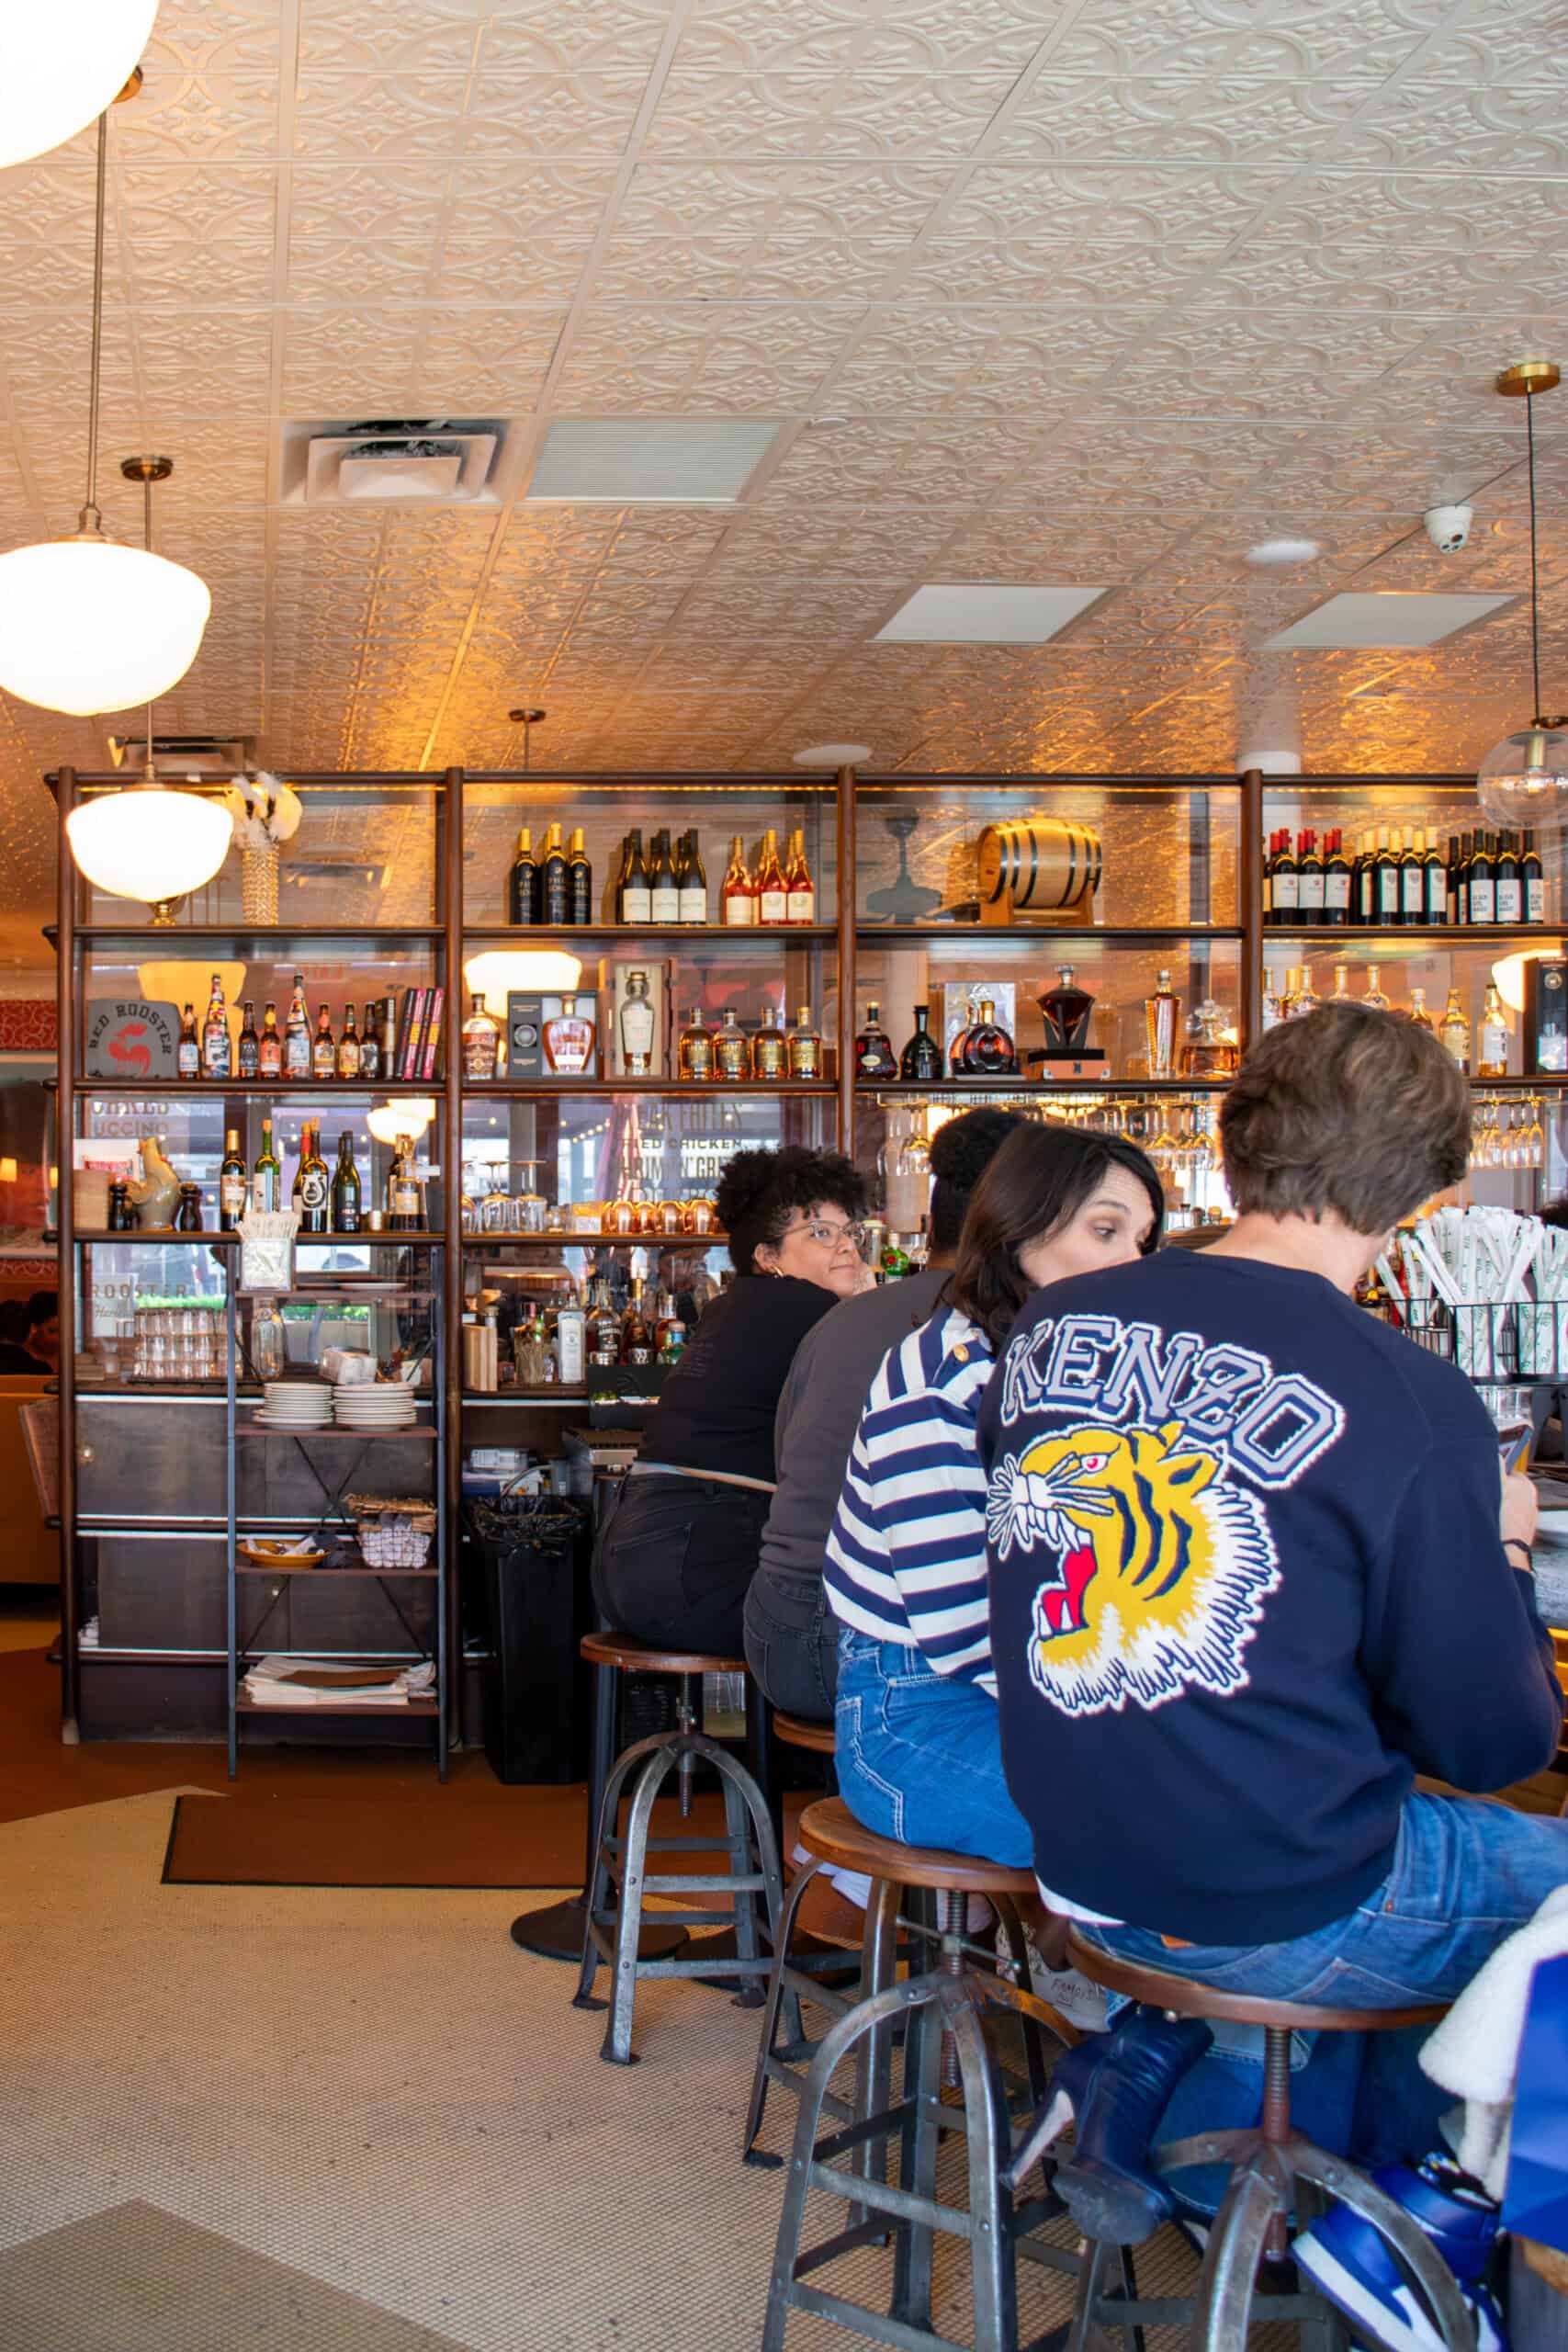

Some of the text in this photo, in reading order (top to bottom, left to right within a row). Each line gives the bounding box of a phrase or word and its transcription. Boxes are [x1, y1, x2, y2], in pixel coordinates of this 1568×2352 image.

[88, 1014, 110, 1049] RED
[116, 1003, 173, 1055] ROOSTER
[94, 1120, 170, 1136] UCCINO
[1001, 1315, 1346, 1490] KENZO
